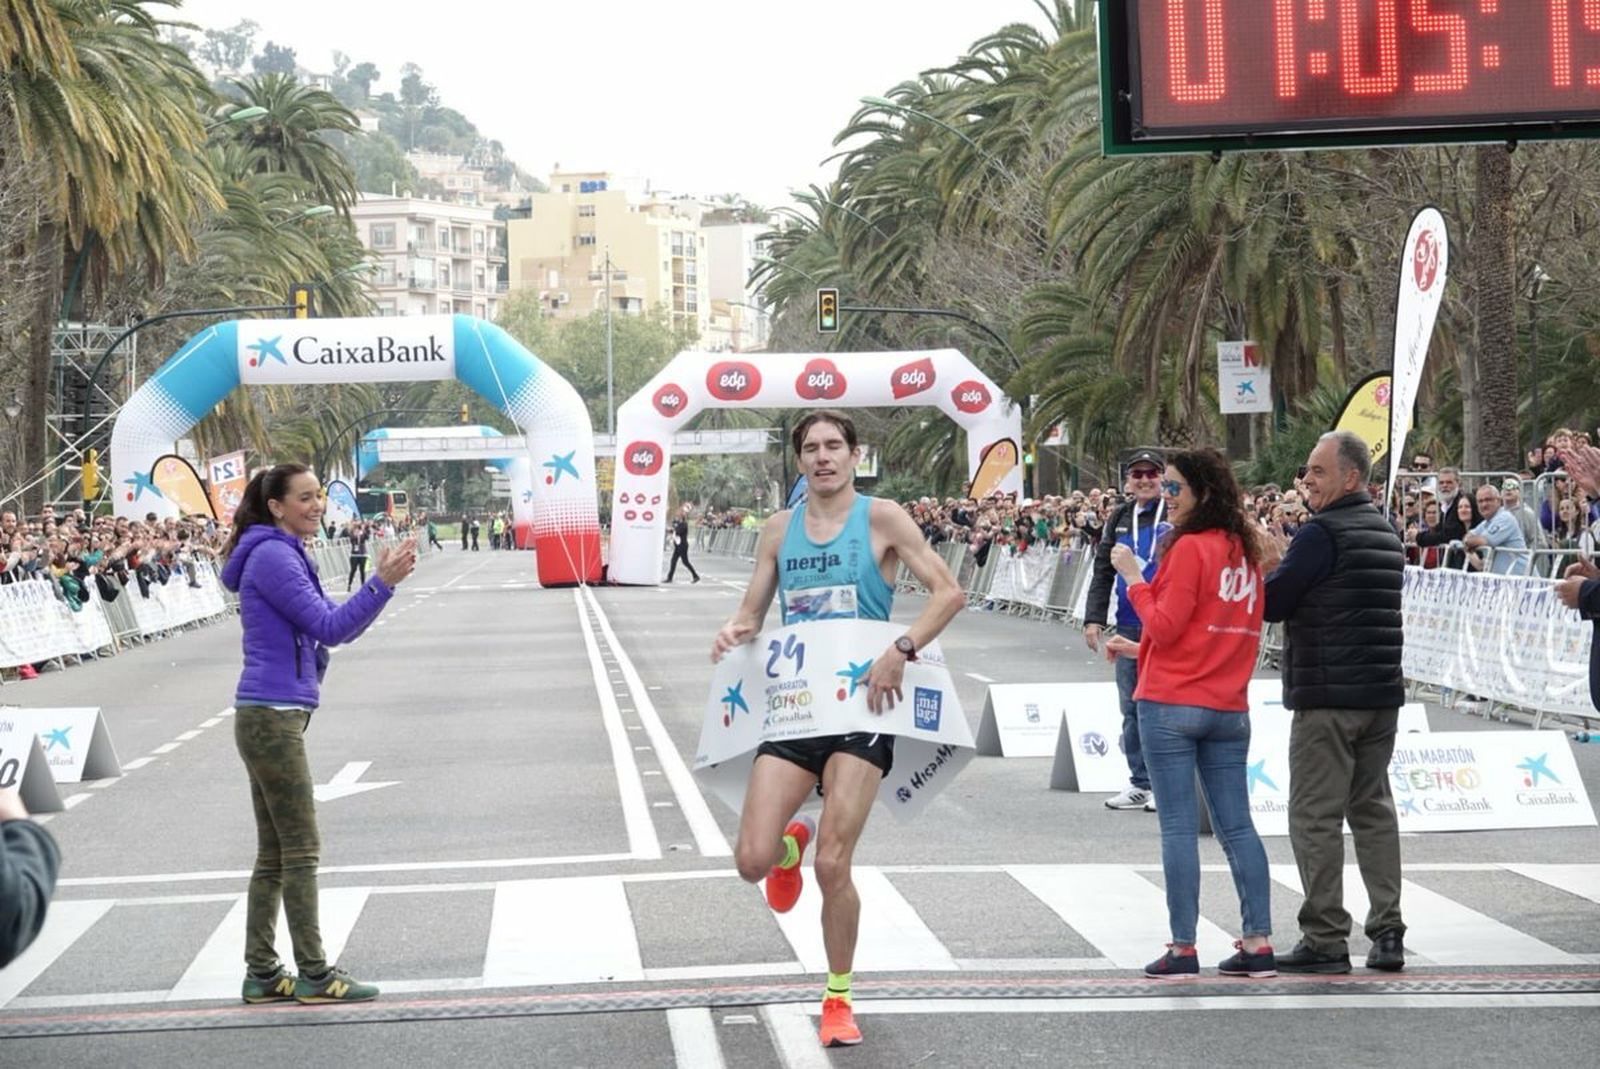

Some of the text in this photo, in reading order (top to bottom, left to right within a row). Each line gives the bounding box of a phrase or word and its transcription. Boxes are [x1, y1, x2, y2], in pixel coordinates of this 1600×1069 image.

[292, 335, 446, 365] CaixaBank
[720, 372, 746, 390] edp
[808, 369, 834, 389] edp
[901, 369, 926, 388] edp
[661, 394, 680, 407] edp
[962, 390, 982, 404] edp
[632, 449, 653, 467] edp
[786, 552, 842, 573] nerja
[1392, 745, 1476, 765] EDIA MARATÓN
[1424, 797, 1493, 813] CaixaBank
[1516, 791, 1579, 807] CaixaBank
